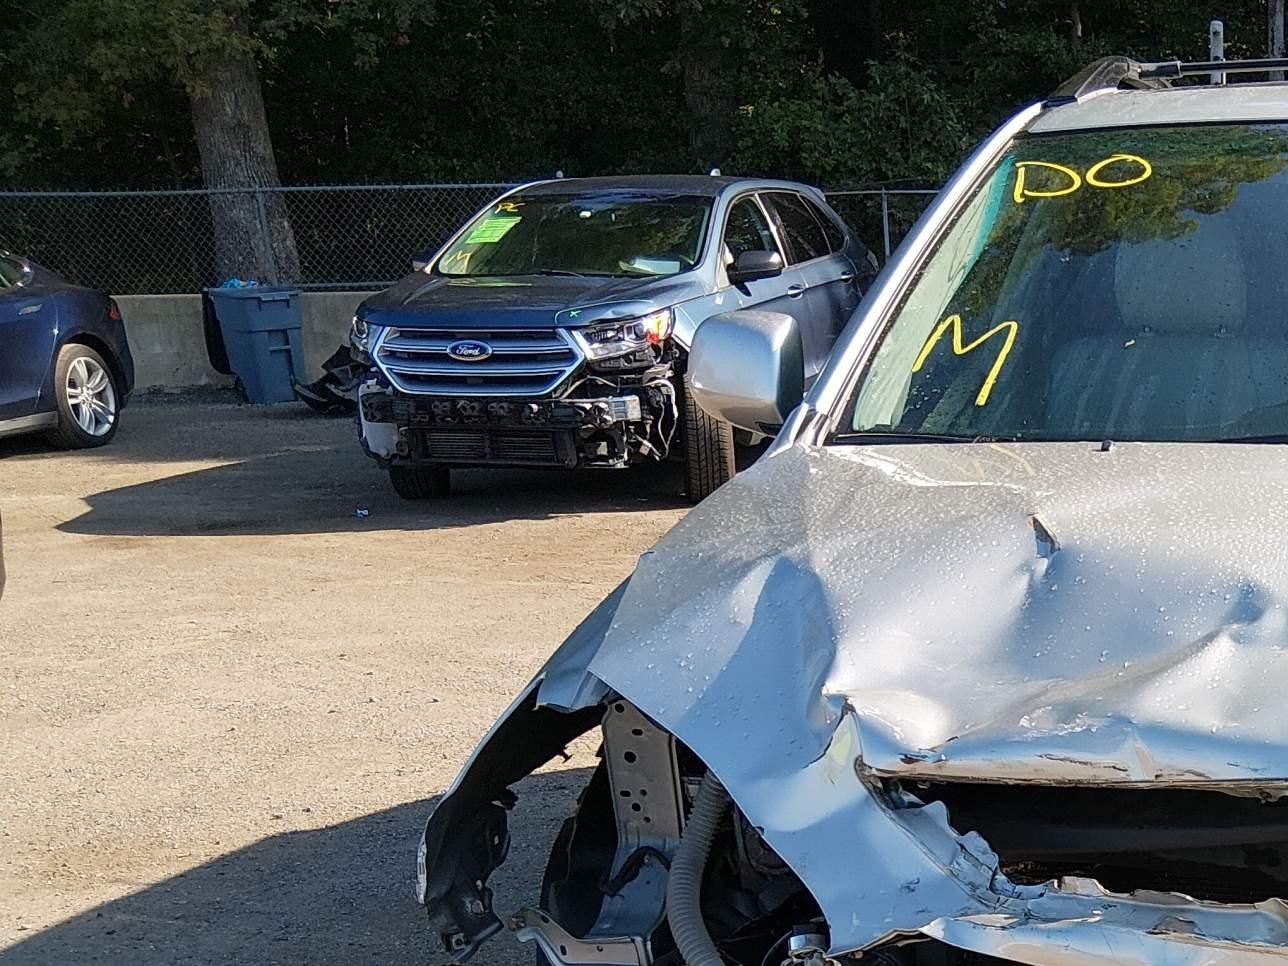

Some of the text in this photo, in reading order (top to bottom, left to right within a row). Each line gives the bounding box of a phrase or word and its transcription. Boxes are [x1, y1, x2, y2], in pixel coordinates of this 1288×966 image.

[1014, 154, 1152, 203] DO
[456, 343, 482, 356] Ford
[912, 314, 1018, 406] M
